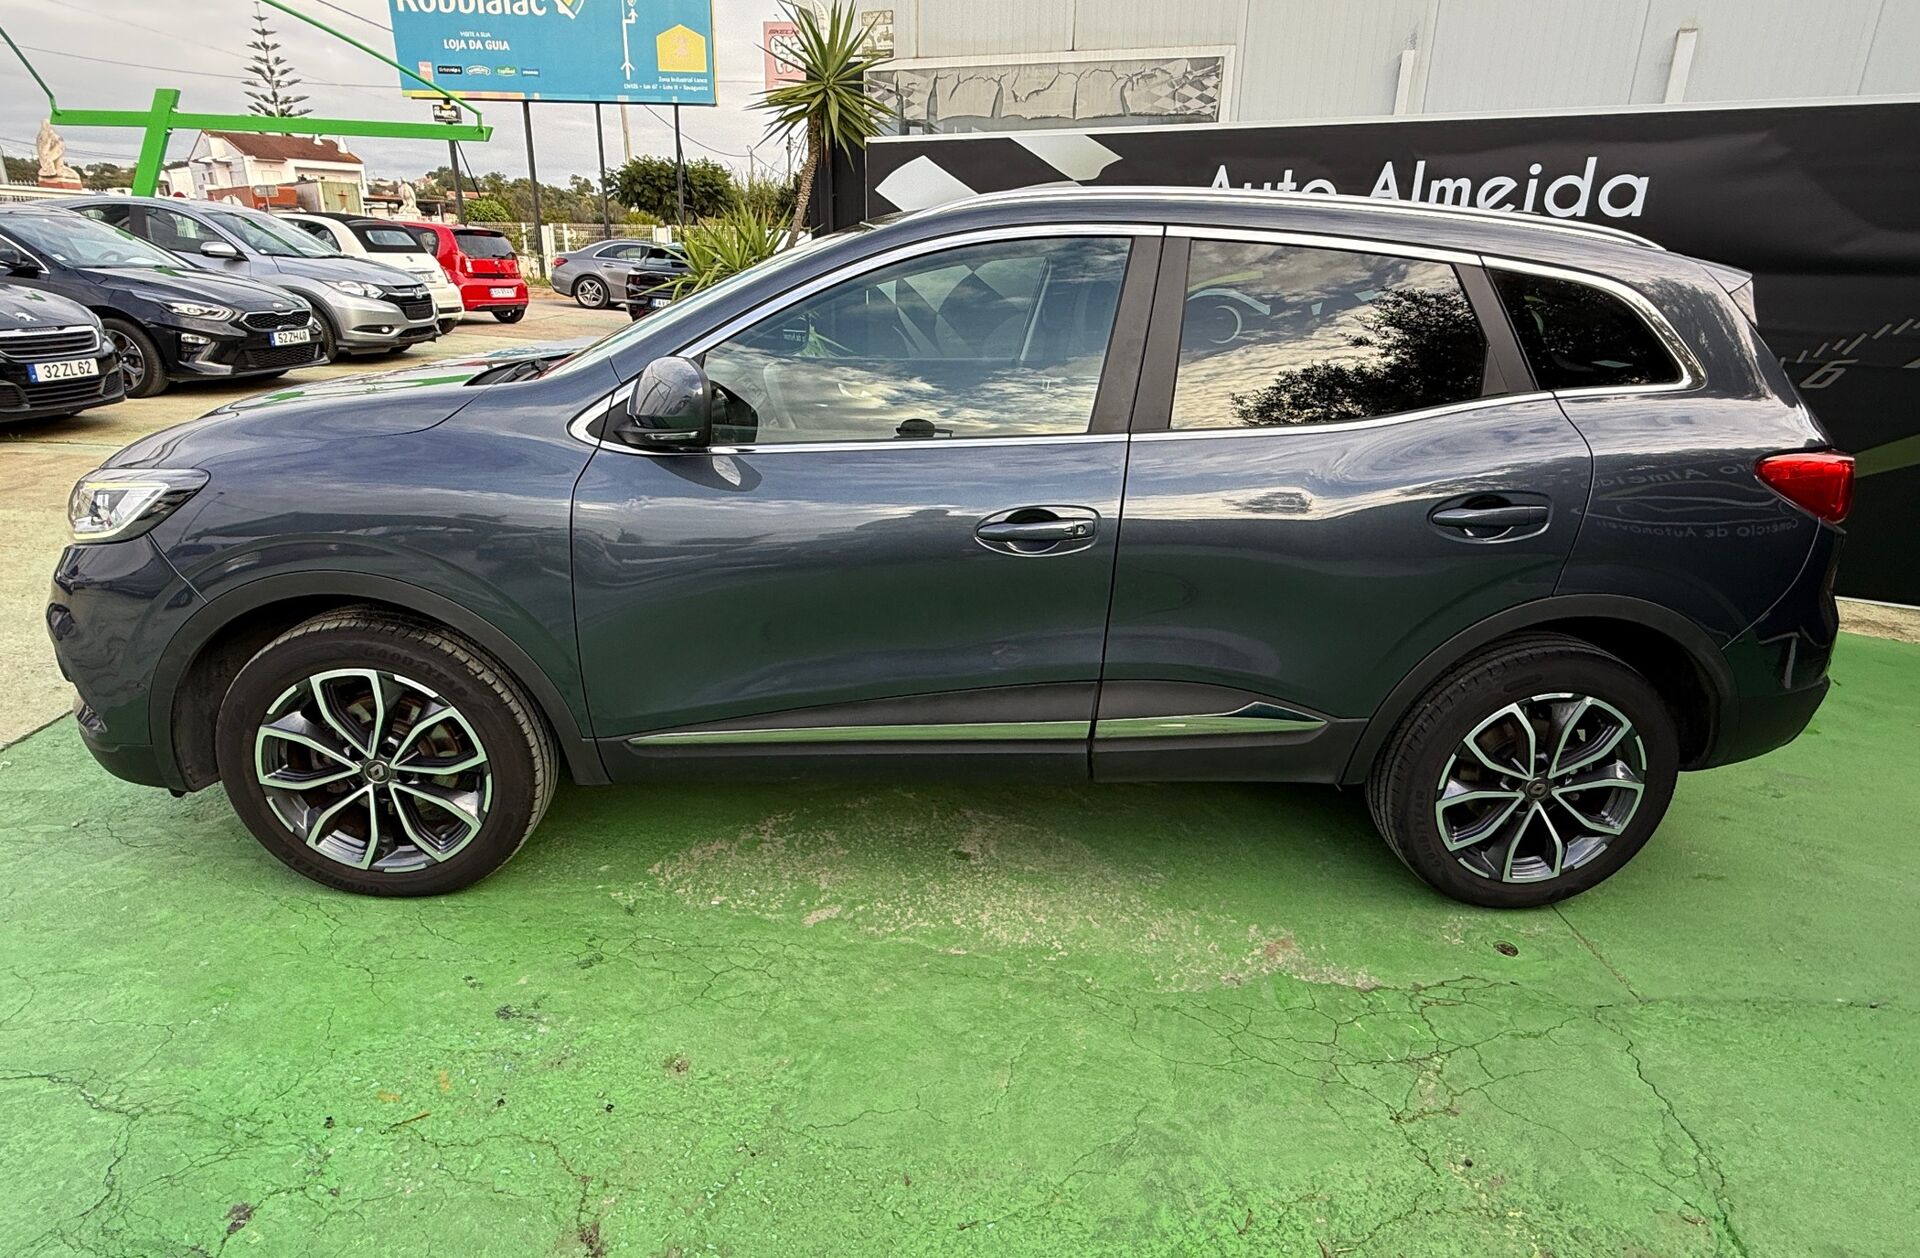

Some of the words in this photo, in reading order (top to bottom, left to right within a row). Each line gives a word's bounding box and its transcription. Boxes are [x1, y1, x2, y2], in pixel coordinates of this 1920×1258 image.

[443, 39, 466, 52] LOJA
[467, 40, 483, 51] DA
[485, 41, 510, 51] GUIA
[1369, 156, 1649, 218] Almeida
[43, 360, 93, 379] 32ZL62
[1799, 359, 1859, 389] 6
